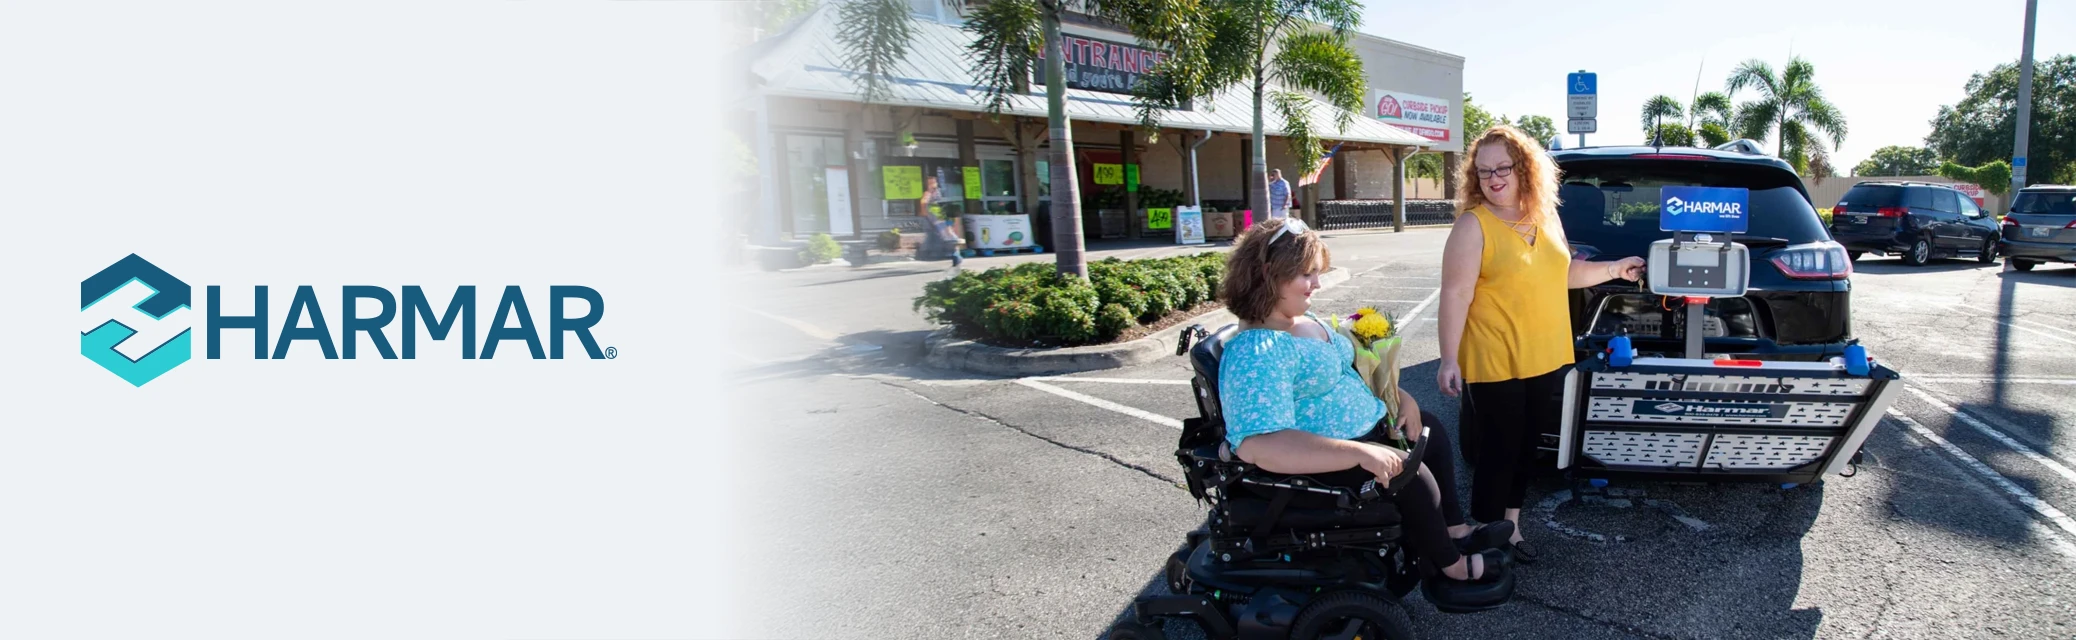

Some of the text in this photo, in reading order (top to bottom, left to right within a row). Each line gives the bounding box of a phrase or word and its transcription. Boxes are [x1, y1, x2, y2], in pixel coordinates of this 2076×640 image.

[1038, 36, 1169, 76] NTRANCE
[1403, 100, 1448, 114] CURBSIDE PICKUP
[1404, 111, 1447, 124] NOW AVAILABLE
